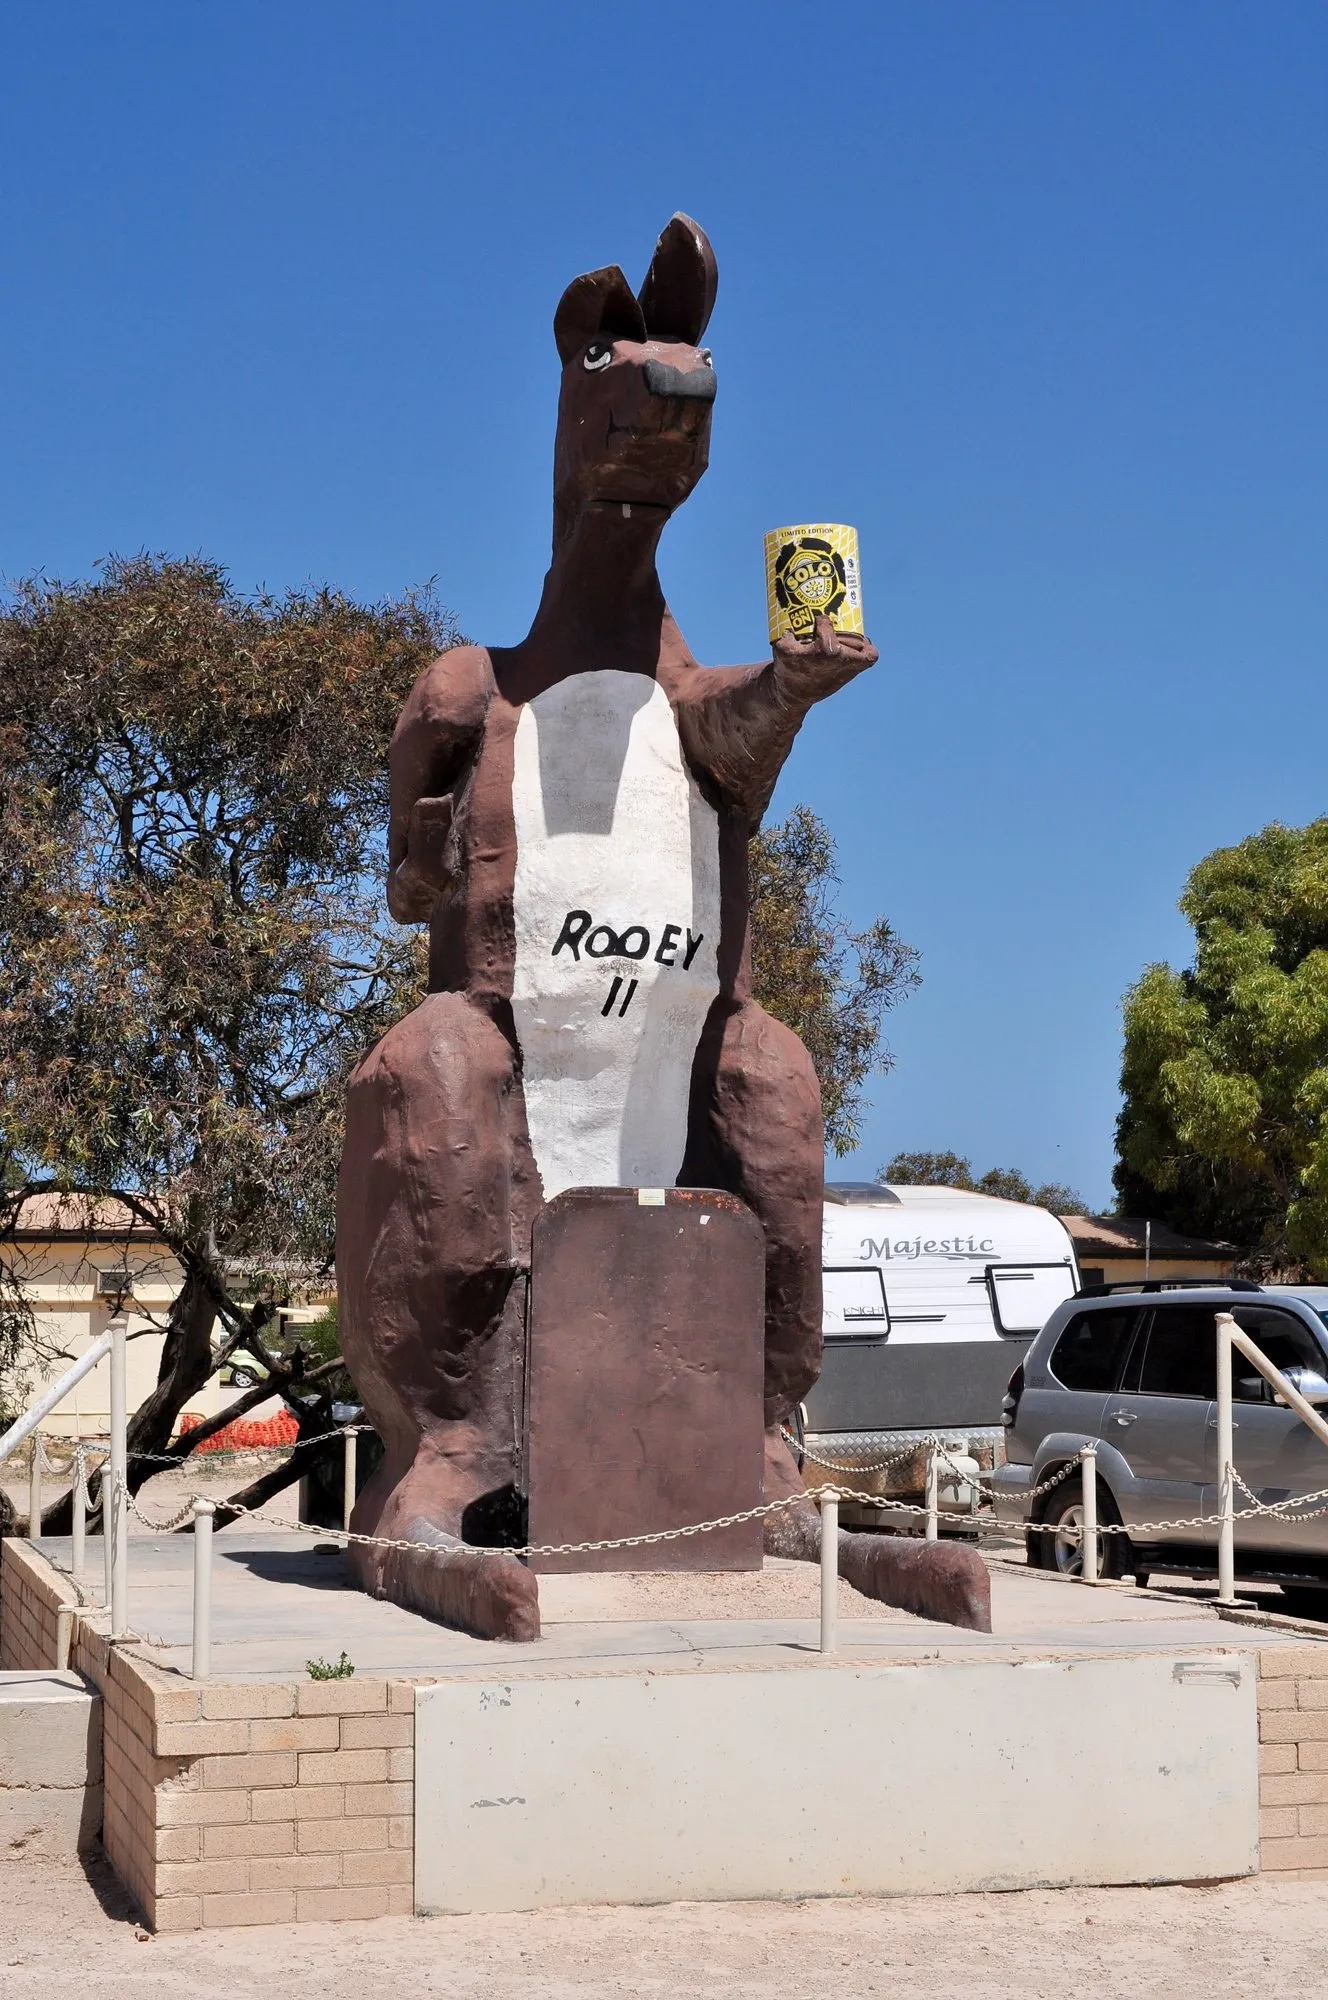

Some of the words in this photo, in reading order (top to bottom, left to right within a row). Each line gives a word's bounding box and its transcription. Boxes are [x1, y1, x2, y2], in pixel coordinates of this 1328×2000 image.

[781, 529, 806, 538] LIMITED
[786, 562, 832, 591] SOLO
[796, 591, 822, 604] ORIGINAL
[790, 607, 808, 620] GAME
[792, 611, 812, 628] ON
[551, 909, 704, 971] ROOEY
[859, 1235, 995, 1261] Majestic
